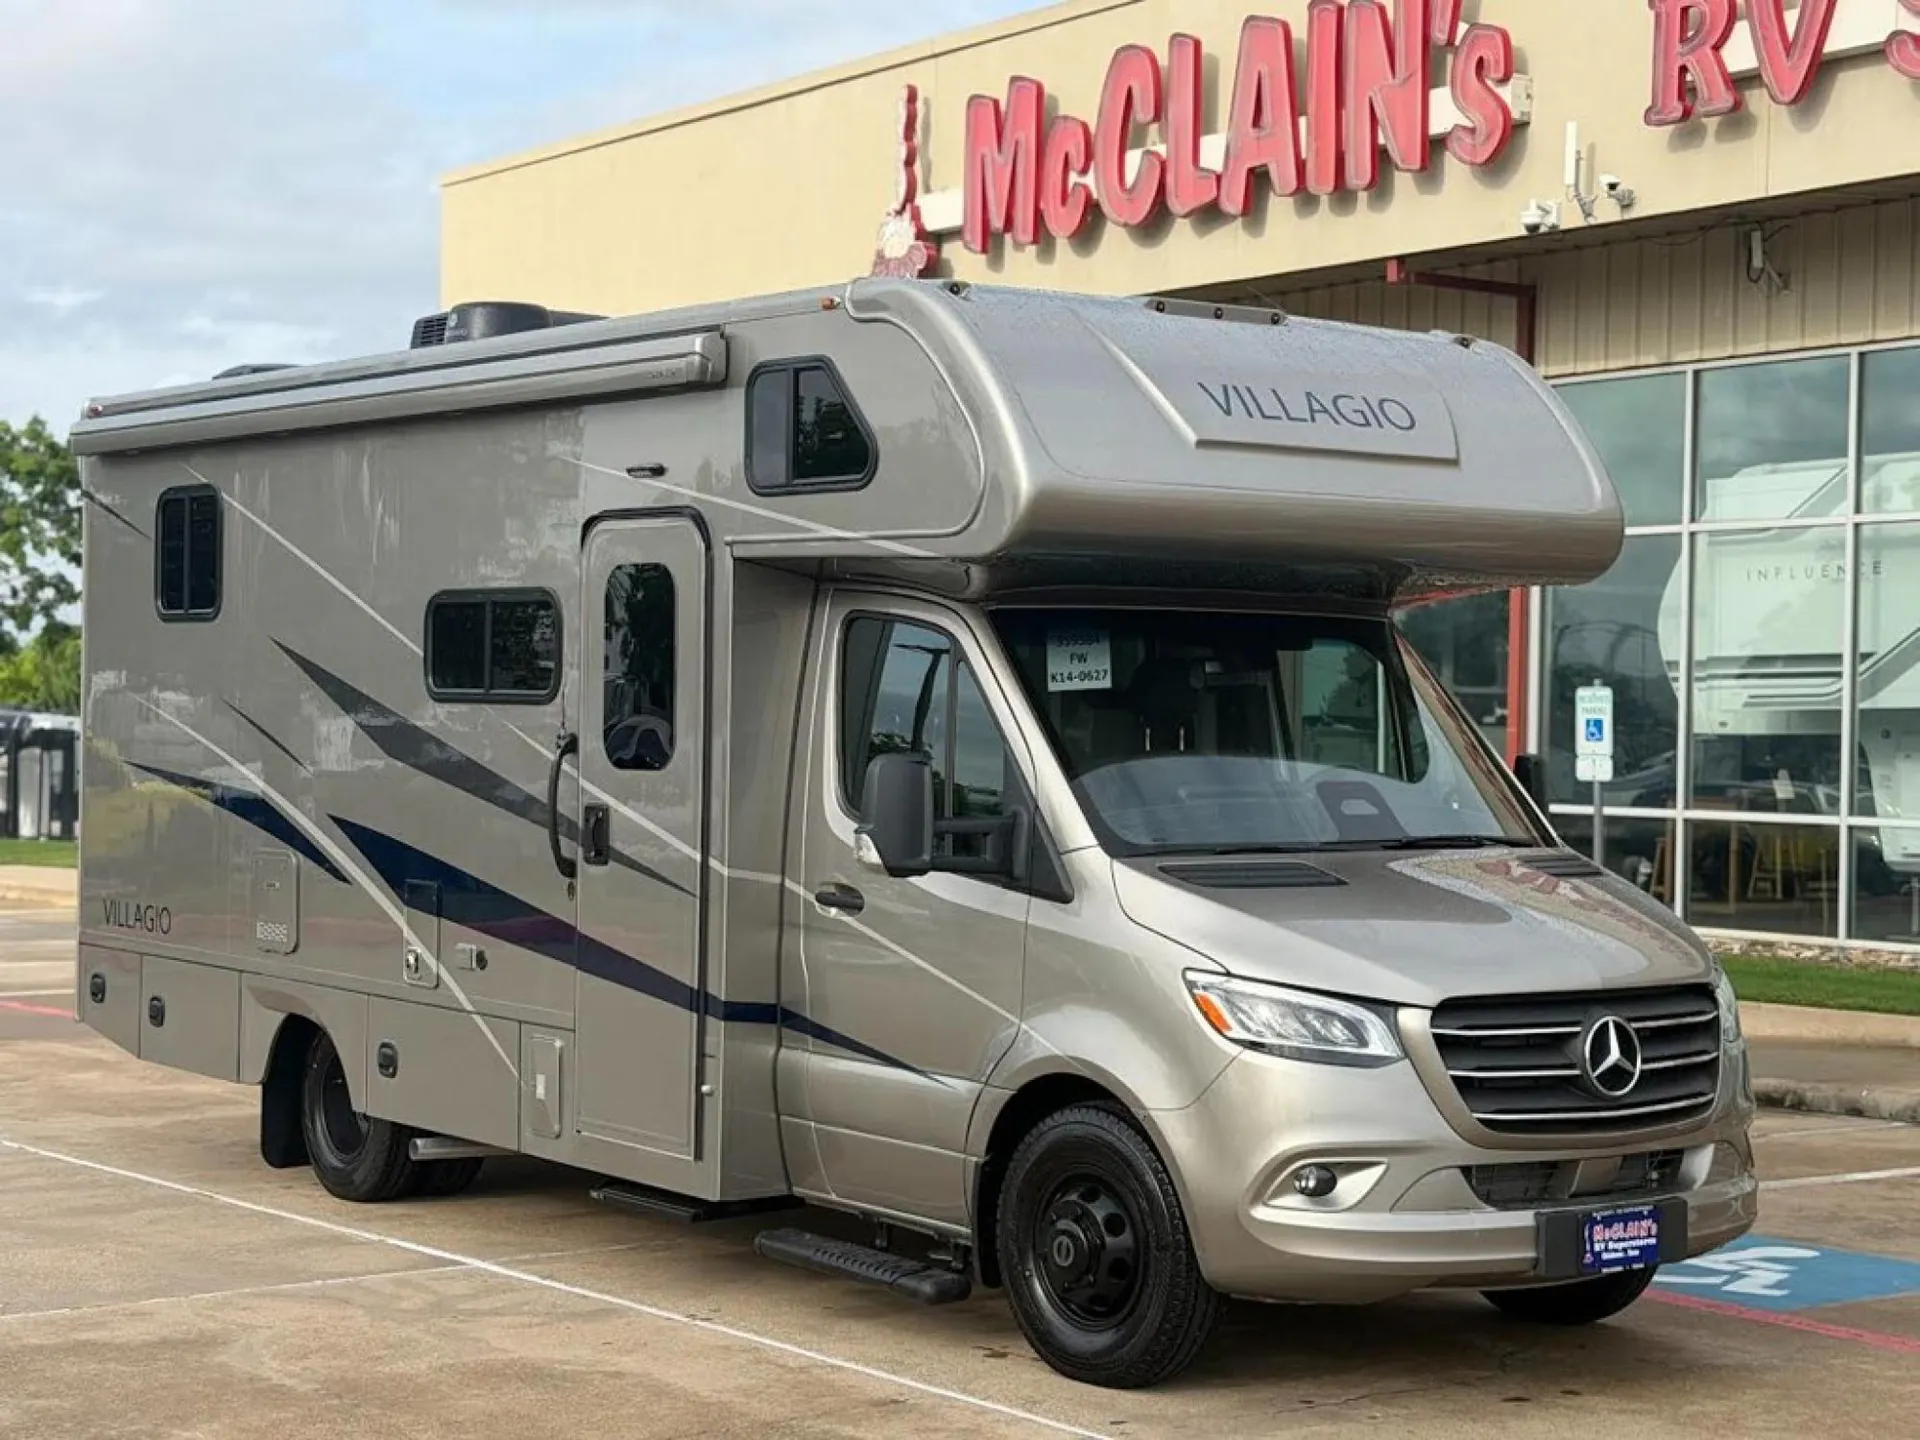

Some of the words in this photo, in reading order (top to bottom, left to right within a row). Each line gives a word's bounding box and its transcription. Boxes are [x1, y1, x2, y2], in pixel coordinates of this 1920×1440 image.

[1644, 0, 1838, 126] RV
[1197, 381, 1417, 431] VILLAGIO
[102, 898, 172, 935] VILLAGIO
